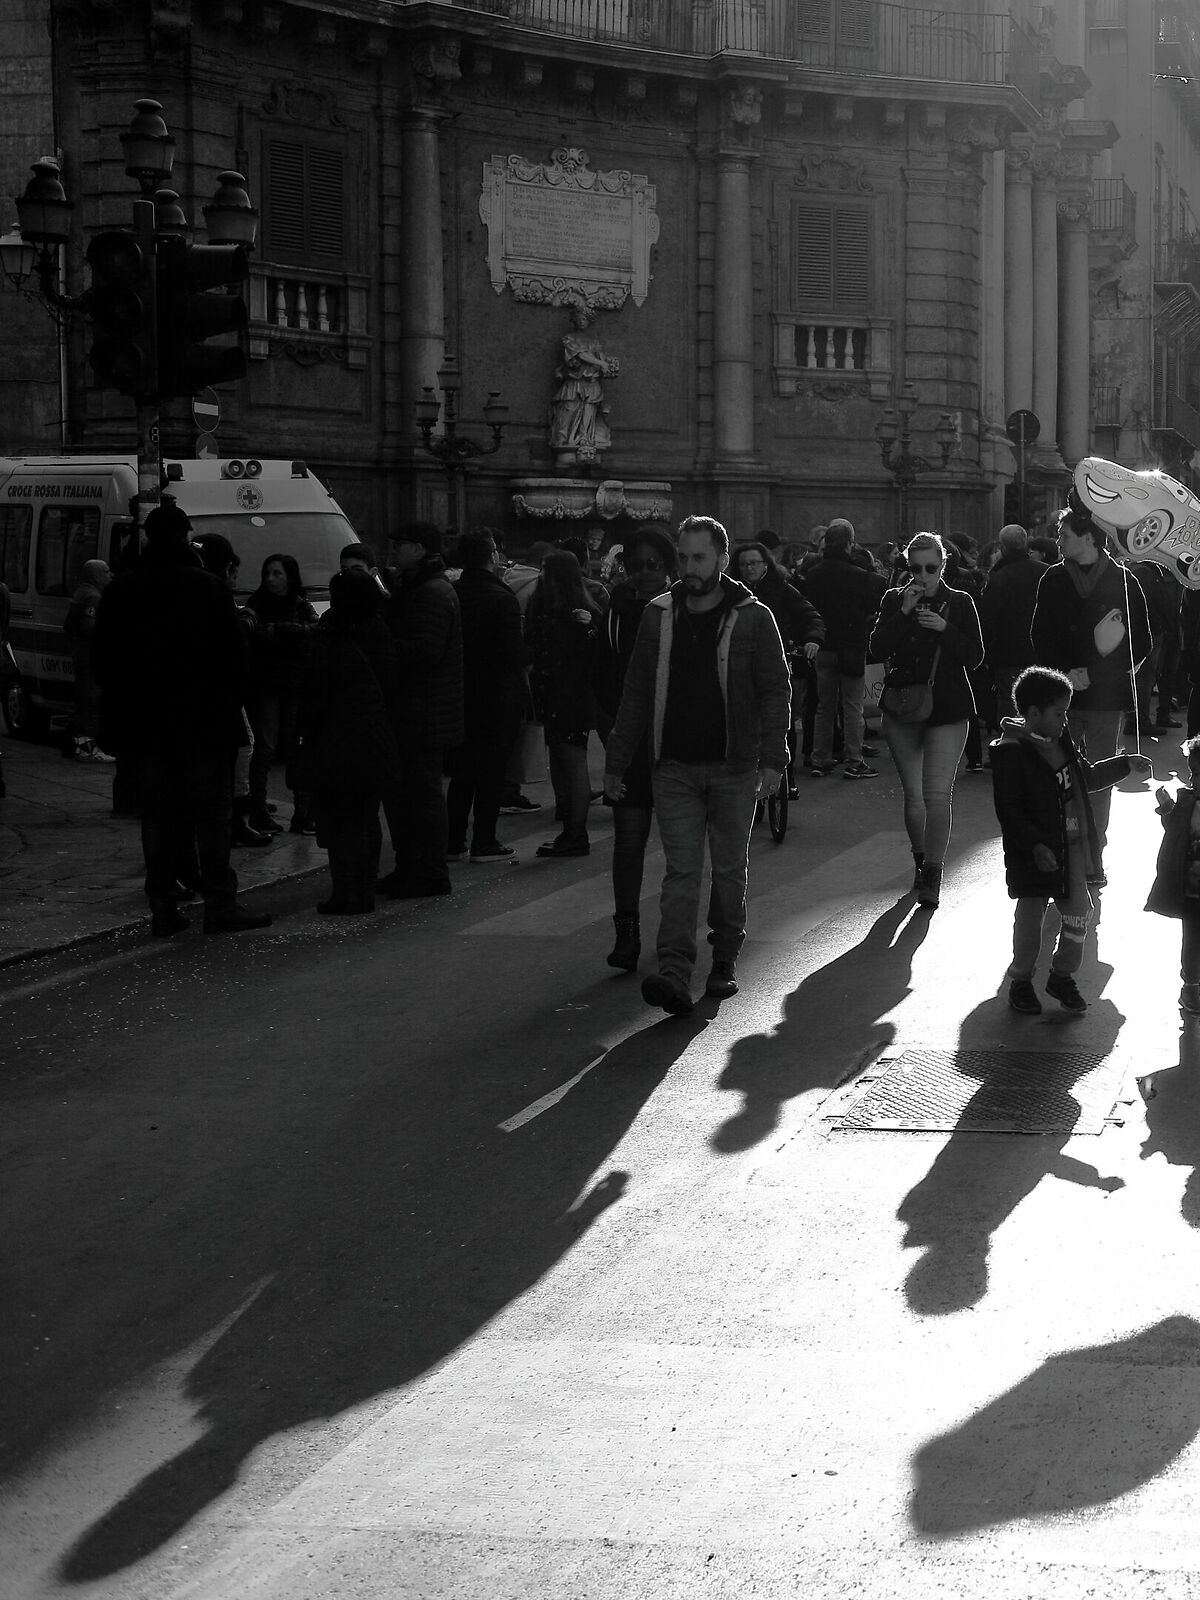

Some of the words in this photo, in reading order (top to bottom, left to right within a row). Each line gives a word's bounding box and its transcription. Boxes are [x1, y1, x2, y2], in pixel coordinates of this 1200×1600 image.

[7, 485, 33, 497] CROCE
[33, 485, 60, 497] ROSSA
[63, 485, 103, 498] ITALIANA
